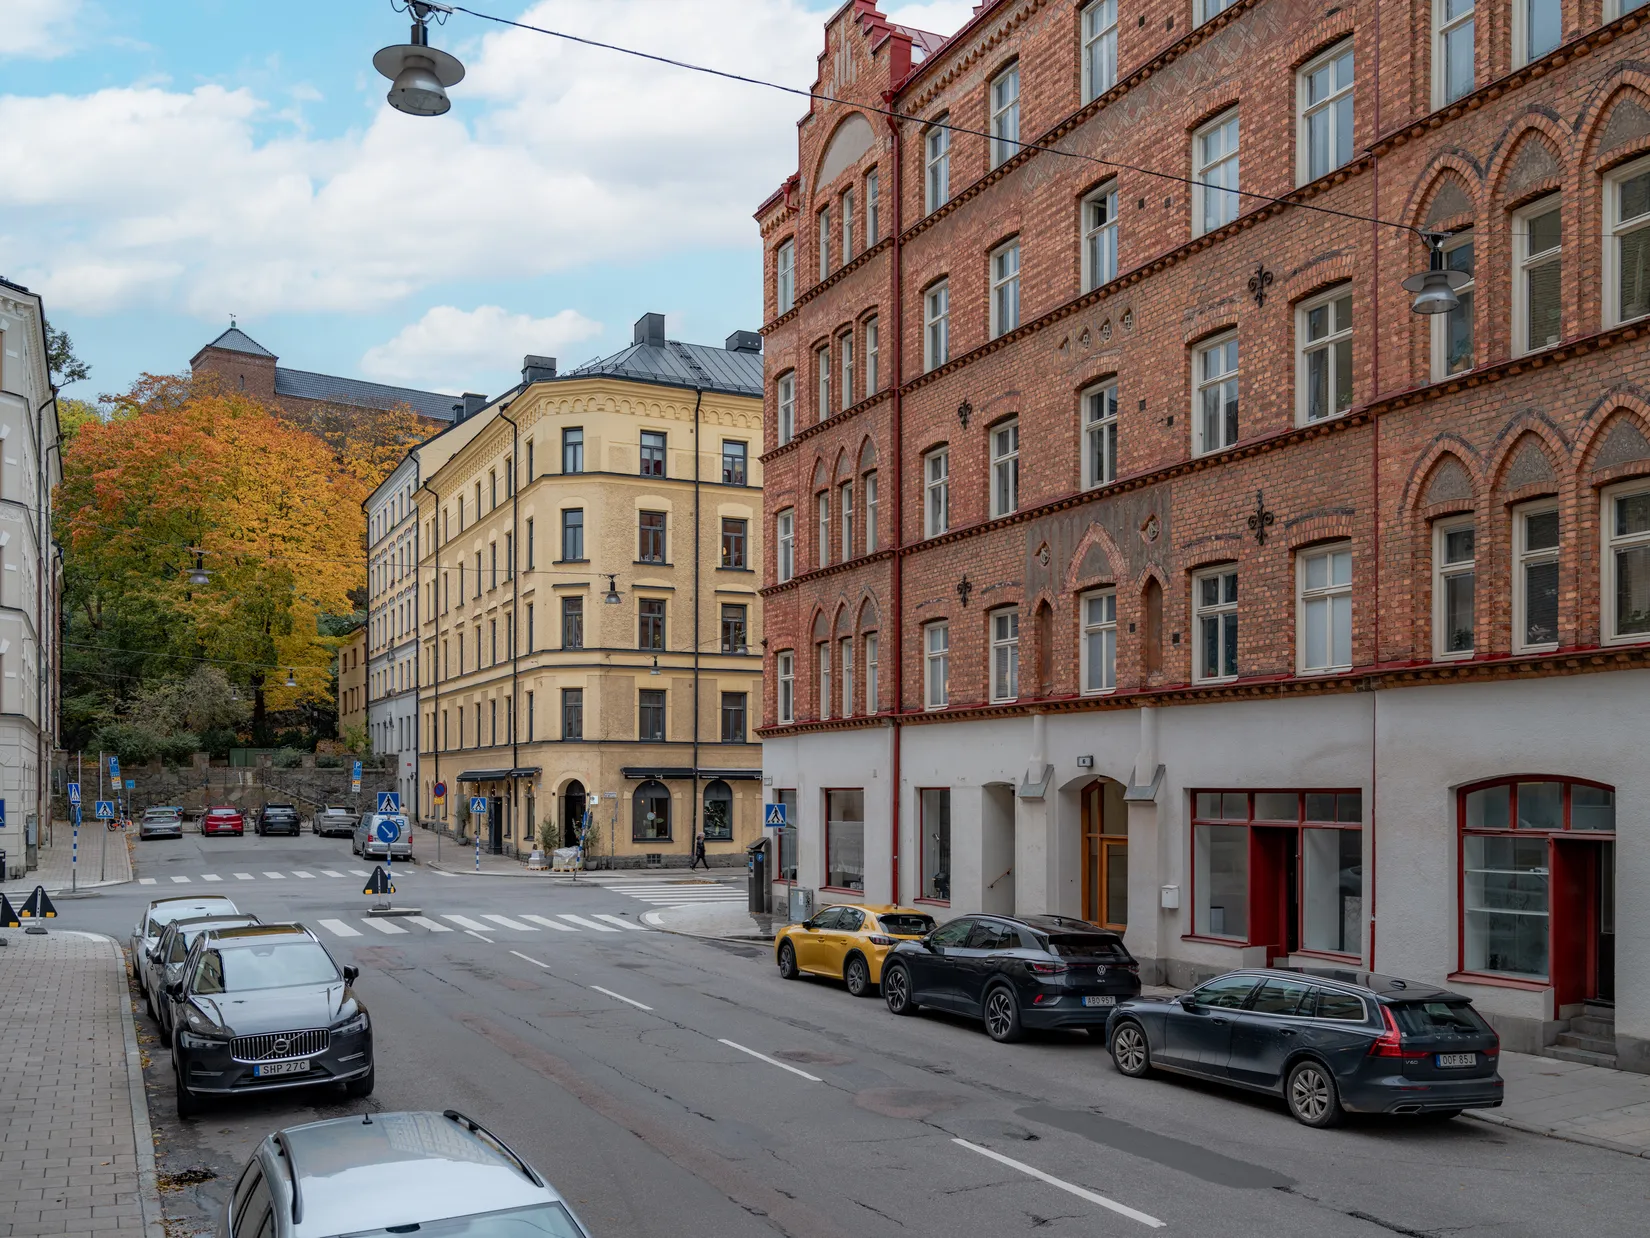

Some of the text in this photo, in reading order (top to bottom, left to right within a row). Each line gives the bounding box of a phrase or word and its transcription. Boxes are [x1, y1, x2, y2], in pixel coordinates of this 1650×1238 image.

[111, 757, 116, 765] P
[1101, 996, 1113, 1005] 957
[1460, 1054, 1473, 1064] 85J
[263, 1061, 306, 1075] SHP 27C
